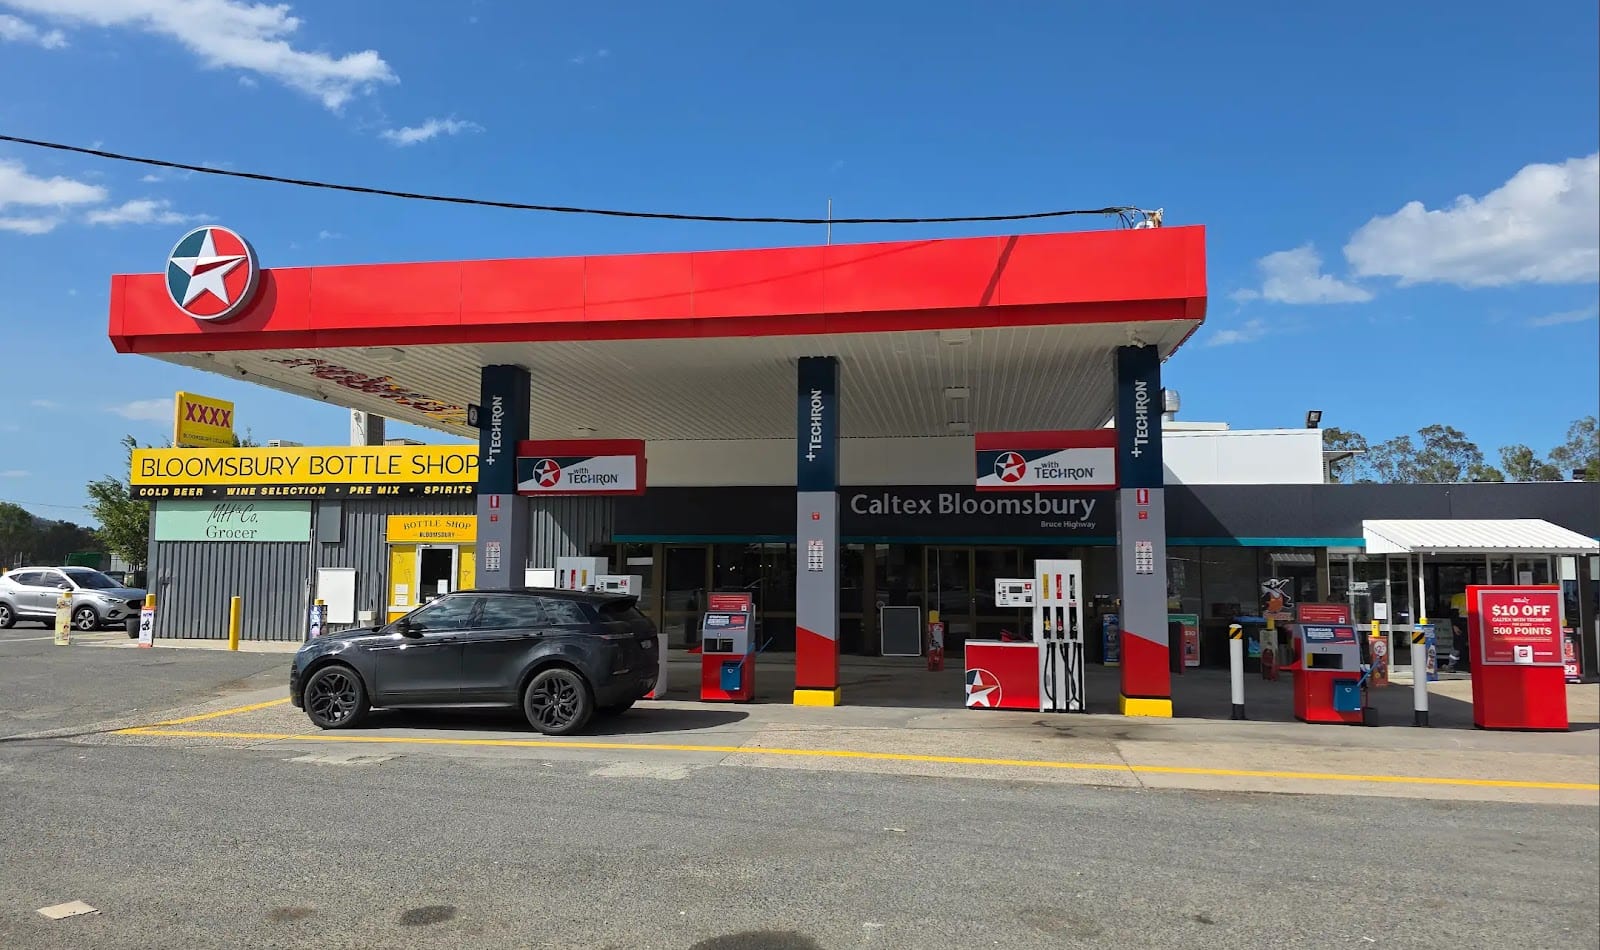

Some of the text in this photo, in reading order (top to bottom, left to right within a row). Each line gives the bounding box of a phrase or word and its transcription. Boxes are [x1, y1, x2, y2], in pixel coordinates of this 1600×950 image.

[185, 402, 231, 428] XXXX
[141, 454, 479, 477] BLOOMSBURY BOTTLE SHOP
[1041, 461, 1058, 469] with
[573, 468, 588, 476] with
[1034, 467, 1093, 481] TECHRON
[567, 474, 618, 486] TECHRON
[139, 485, 473, 497] COLD BEER WINE SELECTION PRE MIX SPIRITS
[850, 492, 1096, 522] Caltex Bloomsbury
[403, 519, 472, 531] BOTTLE SHOP
[1041, 520, 1096, 530] Bruce Highway
[206, 525, 258, 539] Grocer
[1492, 604, 1551, 617] $10 OFF
[1493, 626, 1552, 635] 500 POINTS
